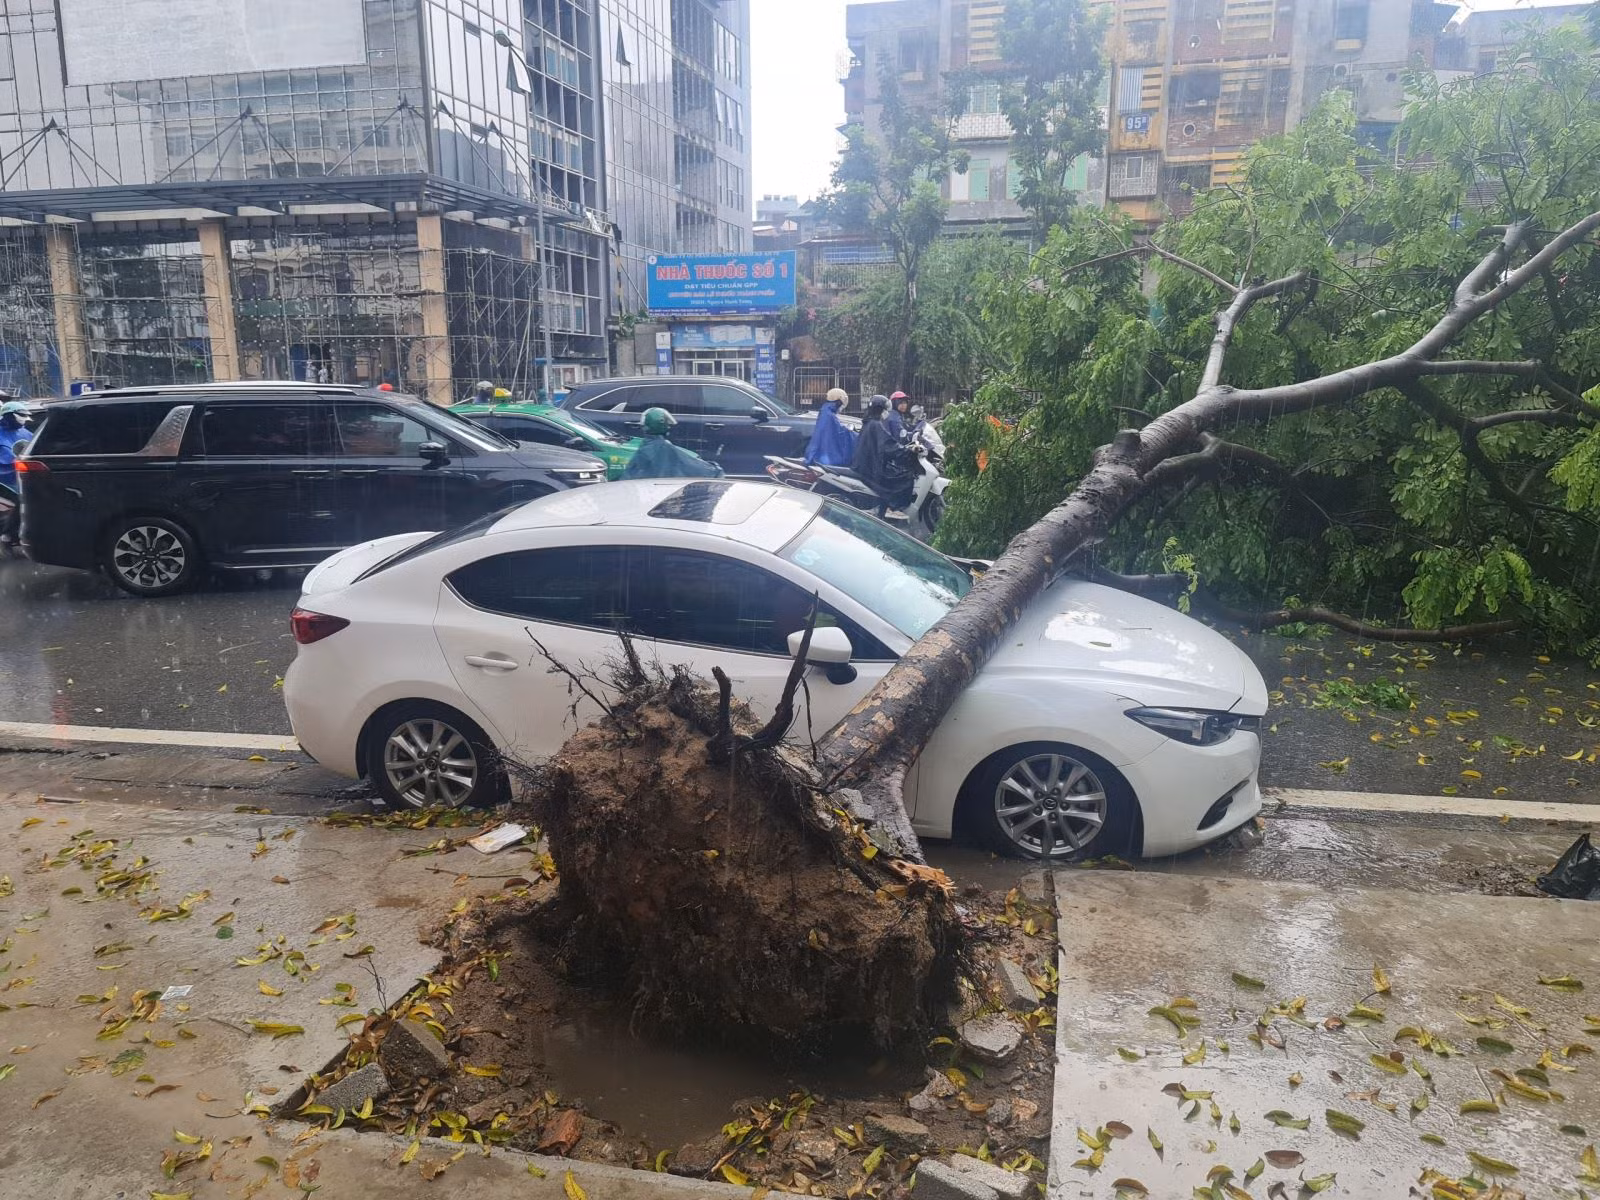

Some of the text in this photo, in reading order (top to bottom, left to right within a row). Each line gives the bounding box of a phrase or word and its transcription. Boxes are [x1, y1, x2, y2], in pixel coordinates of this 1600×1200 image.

[656, 257, 788, 280] NHÀ THUỐC SỐ 1
